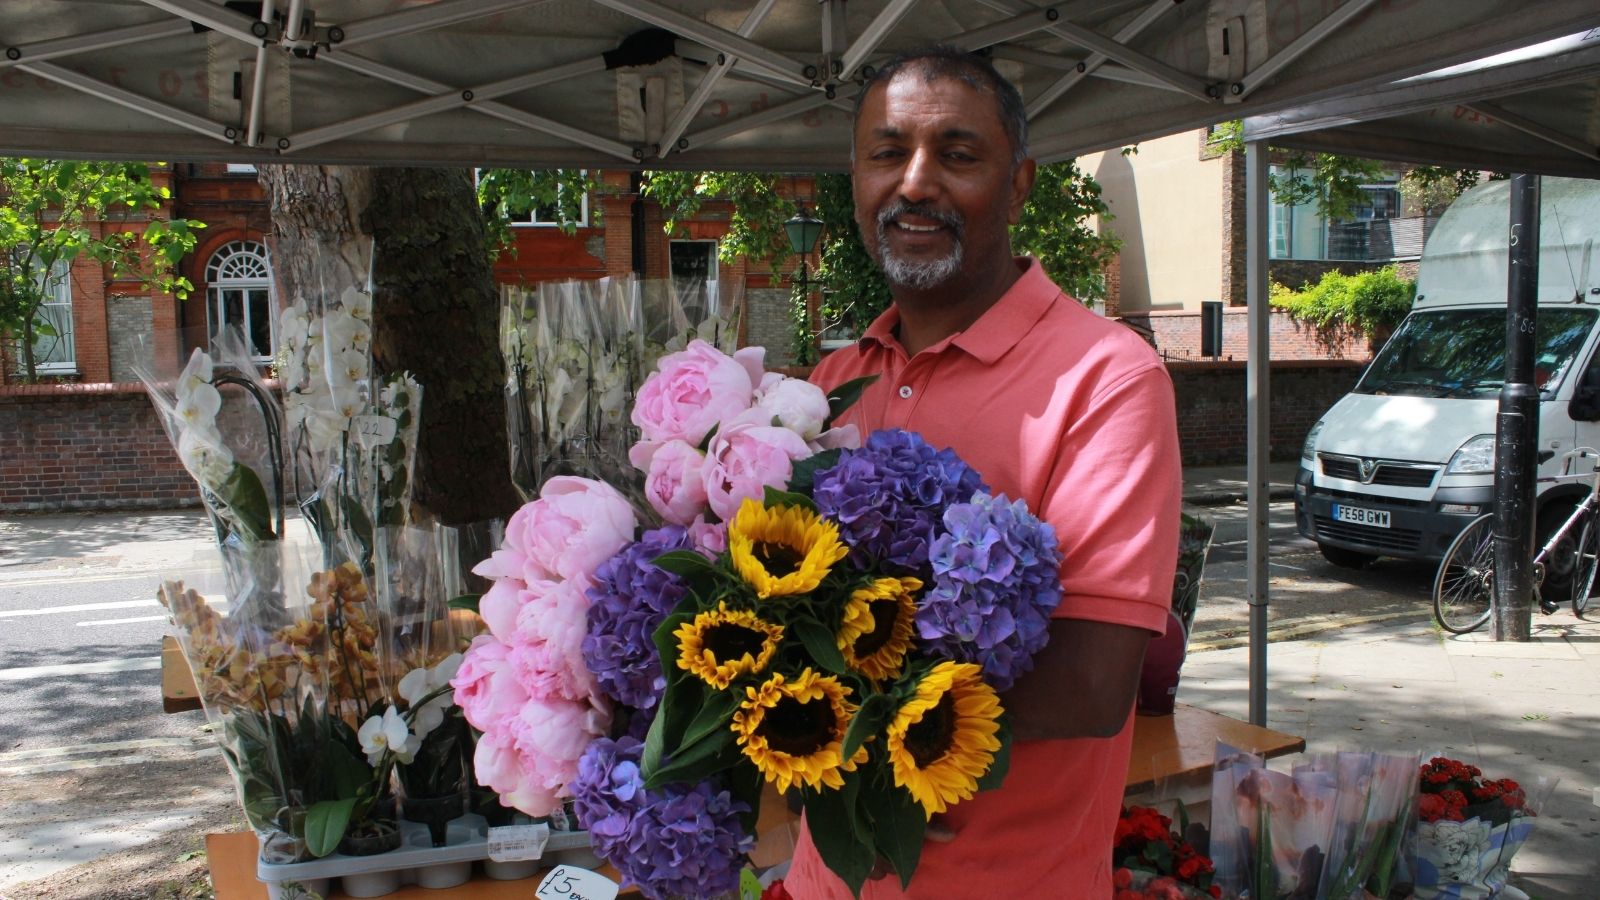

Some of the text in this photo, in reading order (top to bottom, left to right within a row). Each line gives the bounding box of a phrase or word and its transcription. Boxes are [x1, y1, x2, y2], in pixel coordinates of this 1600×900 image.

[1510, 223, 1522, 246] 5
[1338, 506, 1389, 525] FE58 GWW
[539, 868, 581, 895] £5
